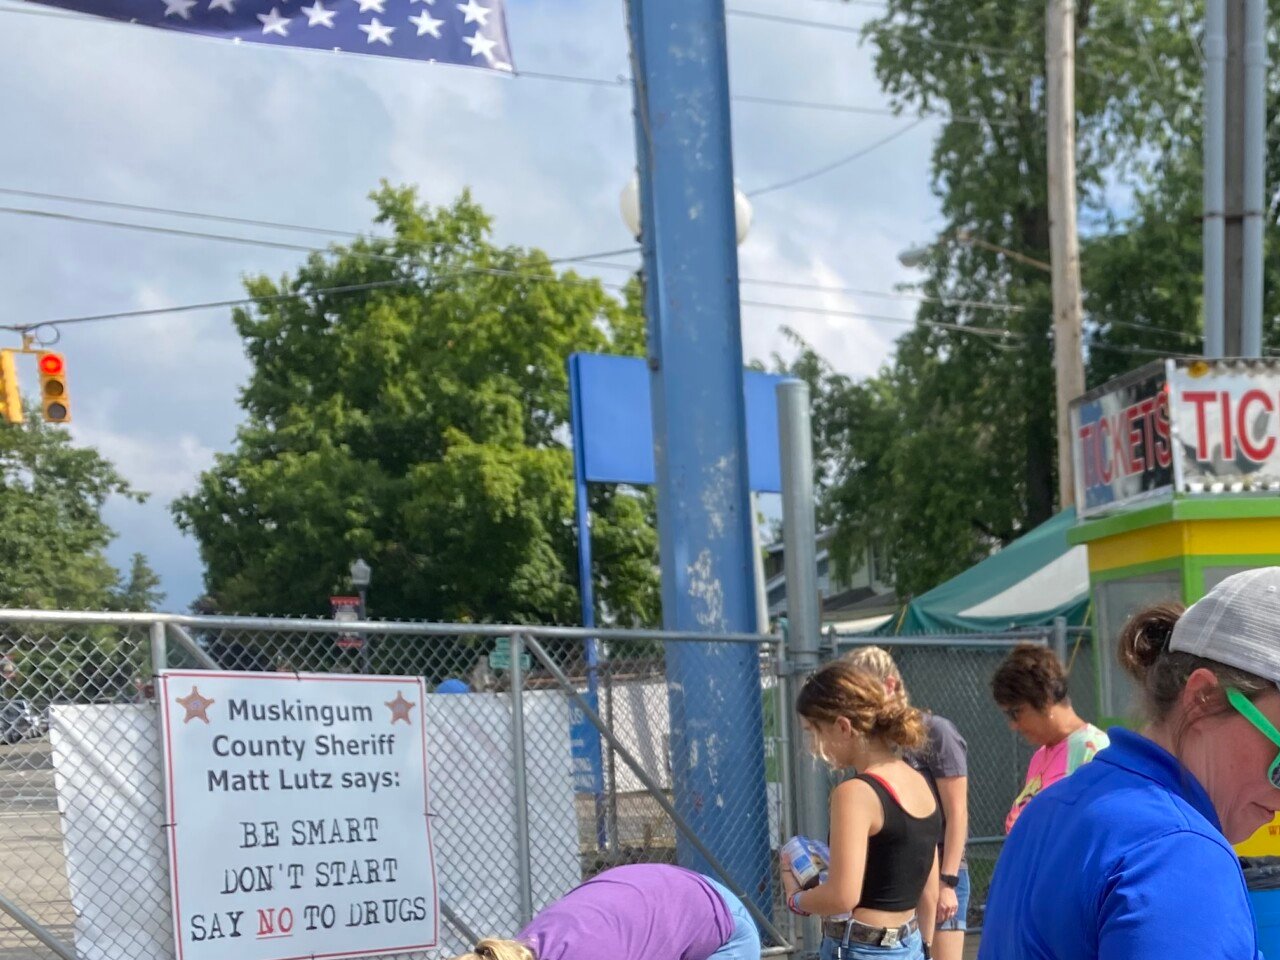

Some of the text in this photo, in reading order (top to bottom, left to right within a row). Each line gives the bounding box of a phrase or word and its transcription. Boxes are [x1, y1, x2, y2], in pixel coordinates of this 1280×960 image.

[1079, 392, 1172, 489] TICKETS
[228, 698, 373, 726] Muskingum
[212, 734, 396, 761] County Sheriff
[207, 768, 401, 793] Matt Lutz says:
[239, 817, 380, 849] BE SMART
[220, 857, 399, 895] DON'T START
[190, 896, 427, 942] SAY NO TO DRUGS
